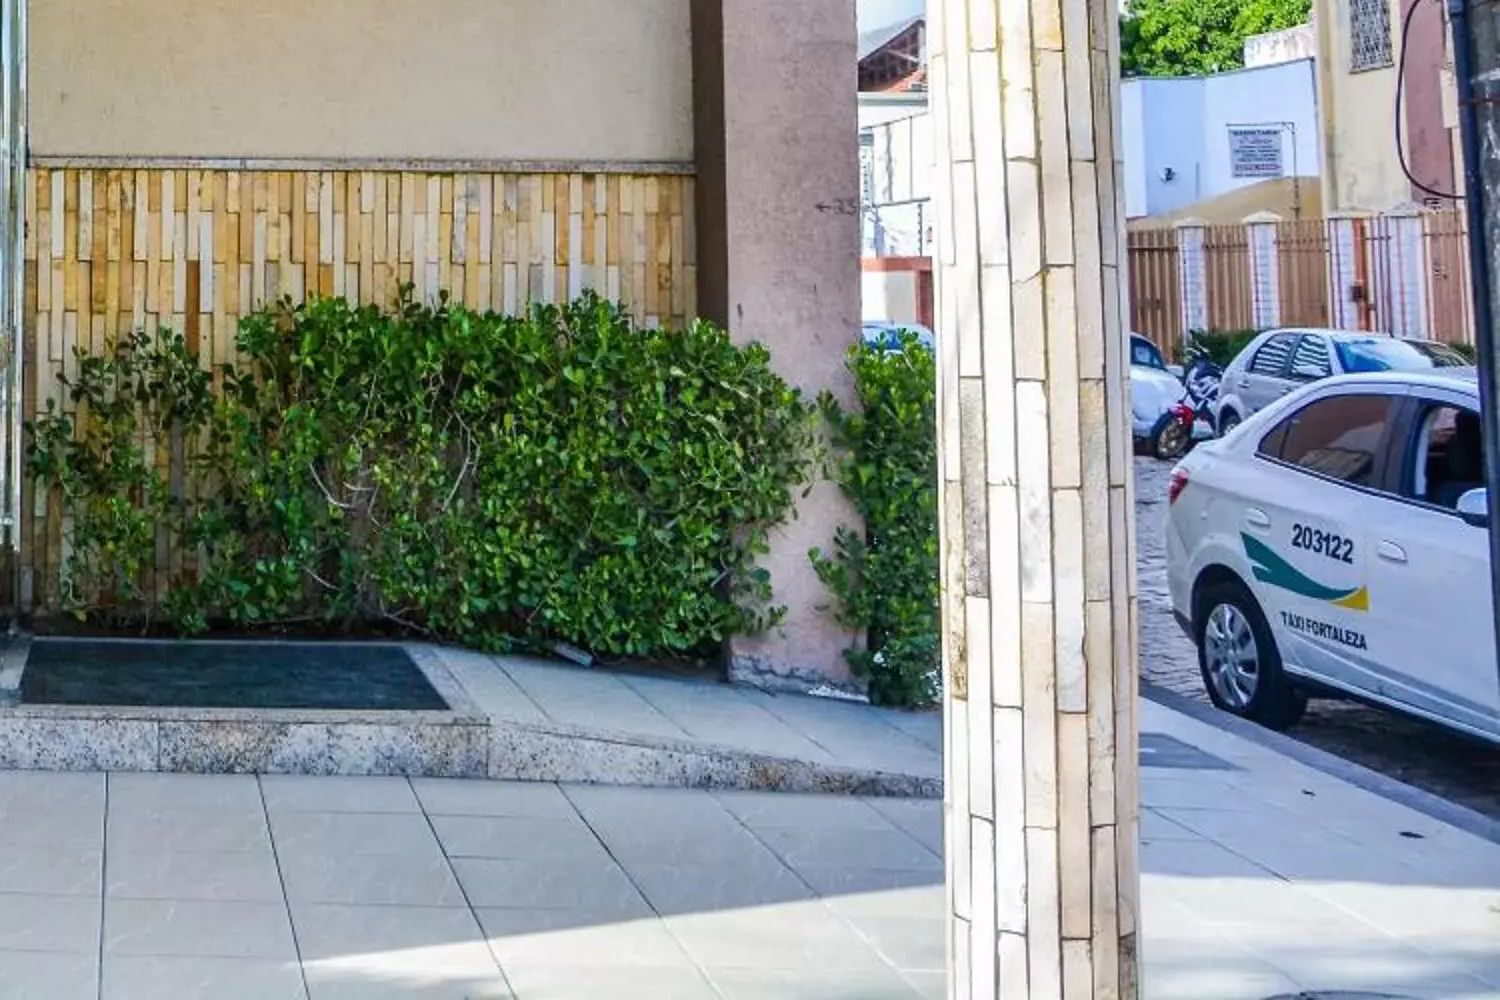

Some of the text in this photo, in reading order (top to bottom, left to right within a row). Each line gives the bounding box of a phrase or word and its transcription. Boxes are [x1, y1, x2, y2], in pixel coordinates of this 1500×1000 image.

[1291, 523, 1354, 565] 203122
[1280, 610, 1368, 650] TAXI FORTALEZA
